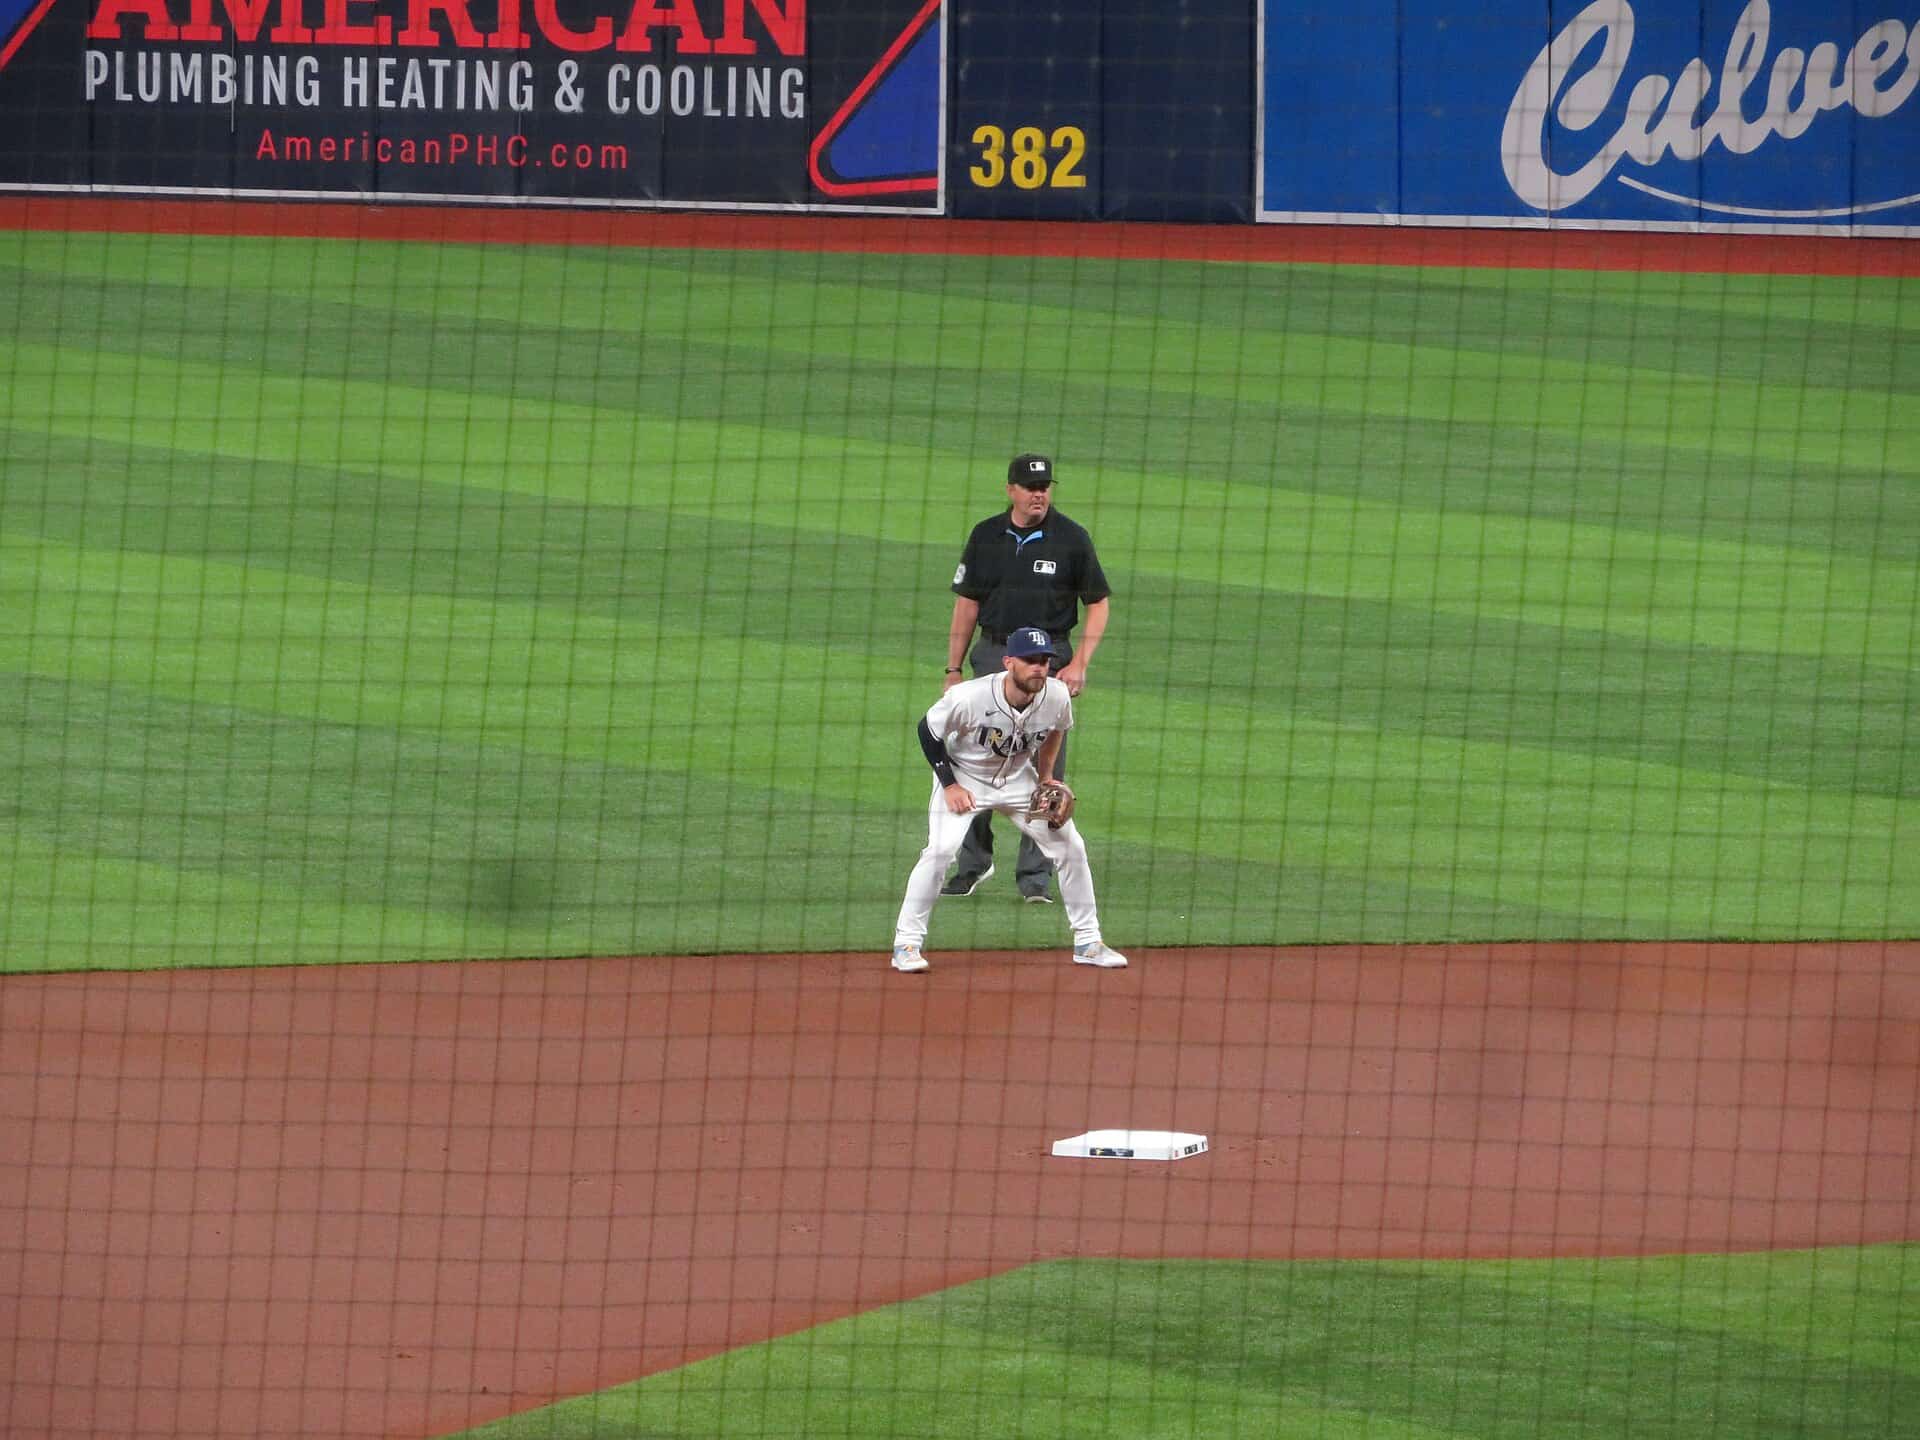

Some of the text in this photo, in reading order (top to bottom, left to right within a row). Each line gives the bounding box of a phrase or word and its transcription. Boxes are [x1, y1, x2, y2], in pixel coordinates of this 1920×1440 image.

[85, 50, 805, 119] PLUMBING HEATING & COOLING
[1501, 0, 1920, 210] Culve
[256, 129, 628, 169] AmericanPHC.com
[969, 125, 1087, 189] 382
